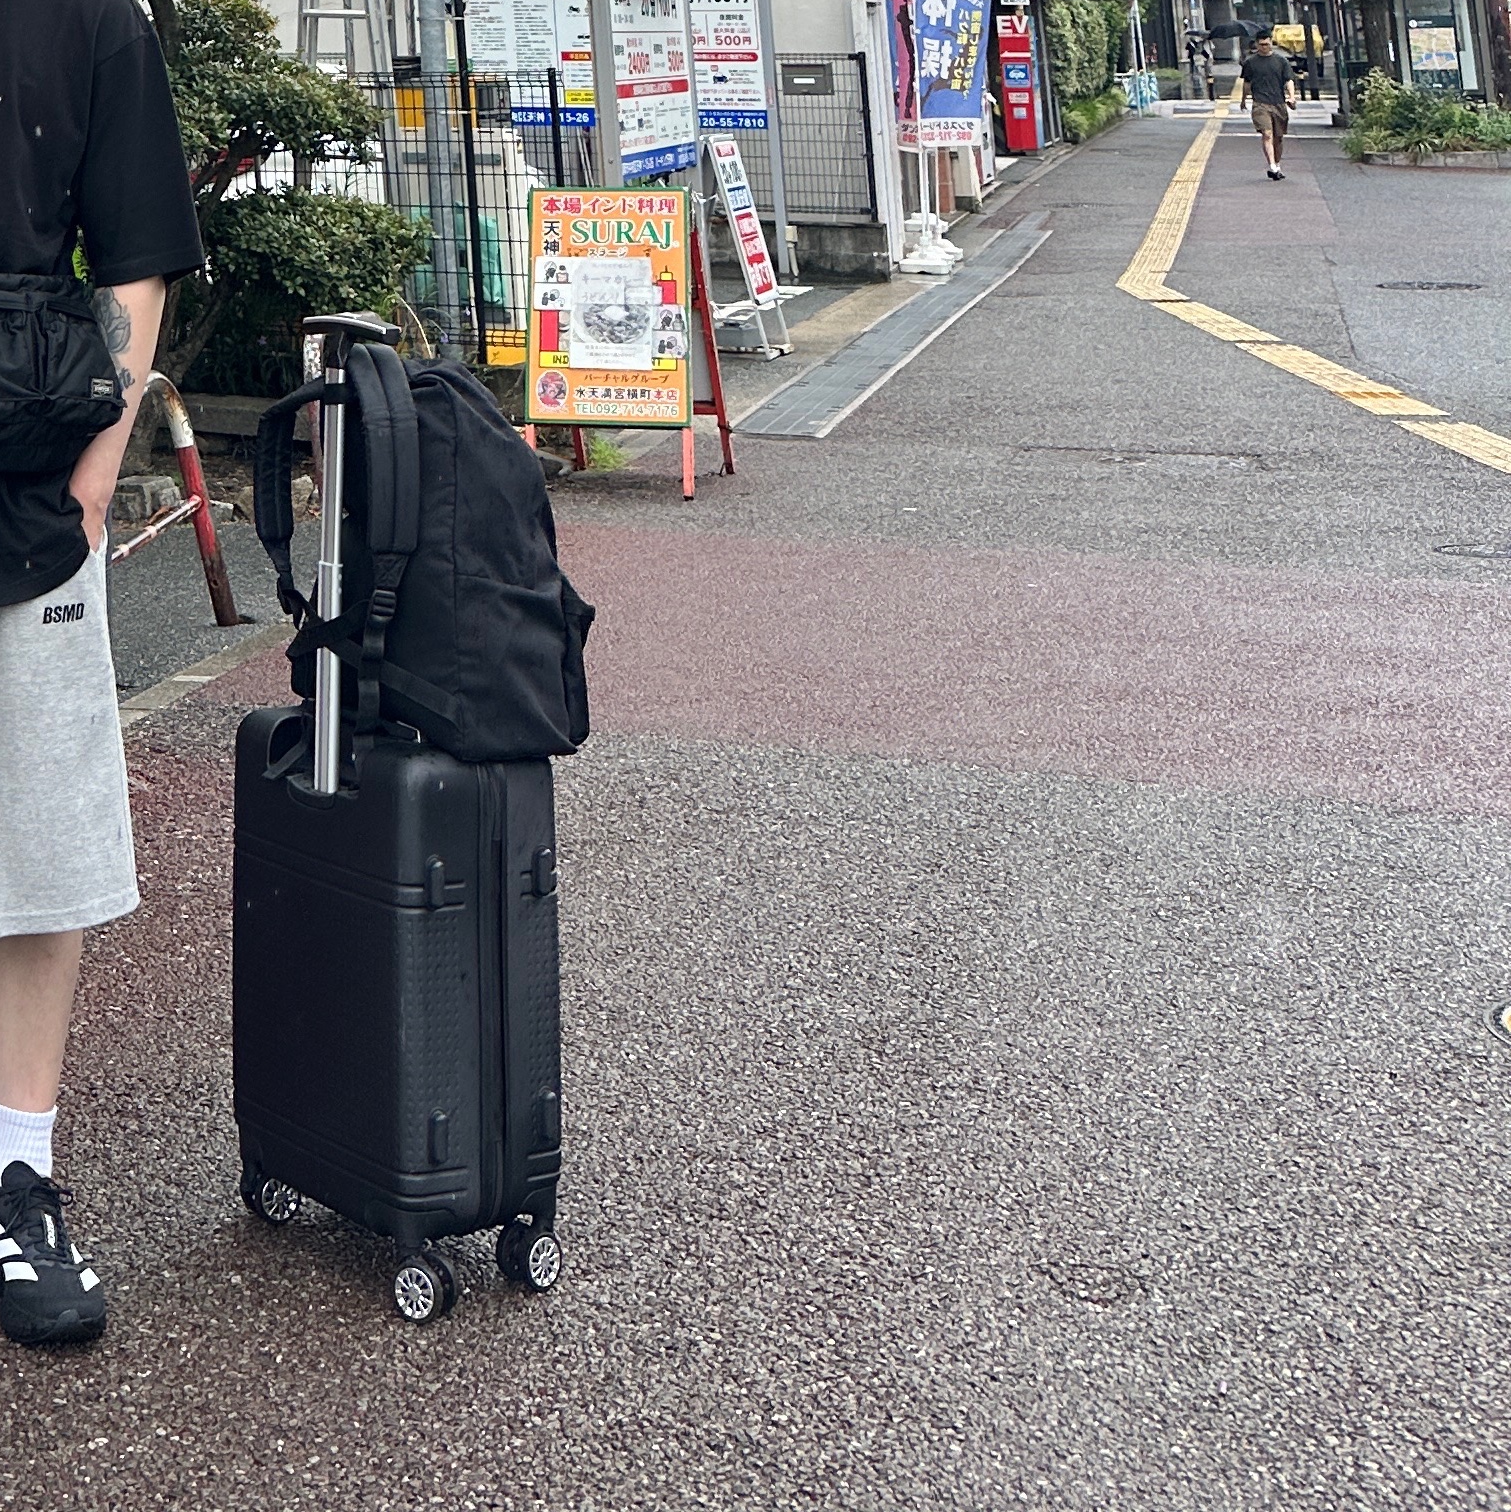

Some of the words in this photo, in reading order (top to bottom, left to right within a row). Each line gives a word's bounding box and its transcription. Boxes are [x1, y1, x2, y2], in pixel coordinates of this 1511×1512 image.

[995, 14, 1030, 35] EV
[714, 34, 752, 46] 500円
[542, 196, 676, 215] 本場インド料理
[543, 220, 560, 256] 天神
[571, 219, 672, 250] SURAJ
